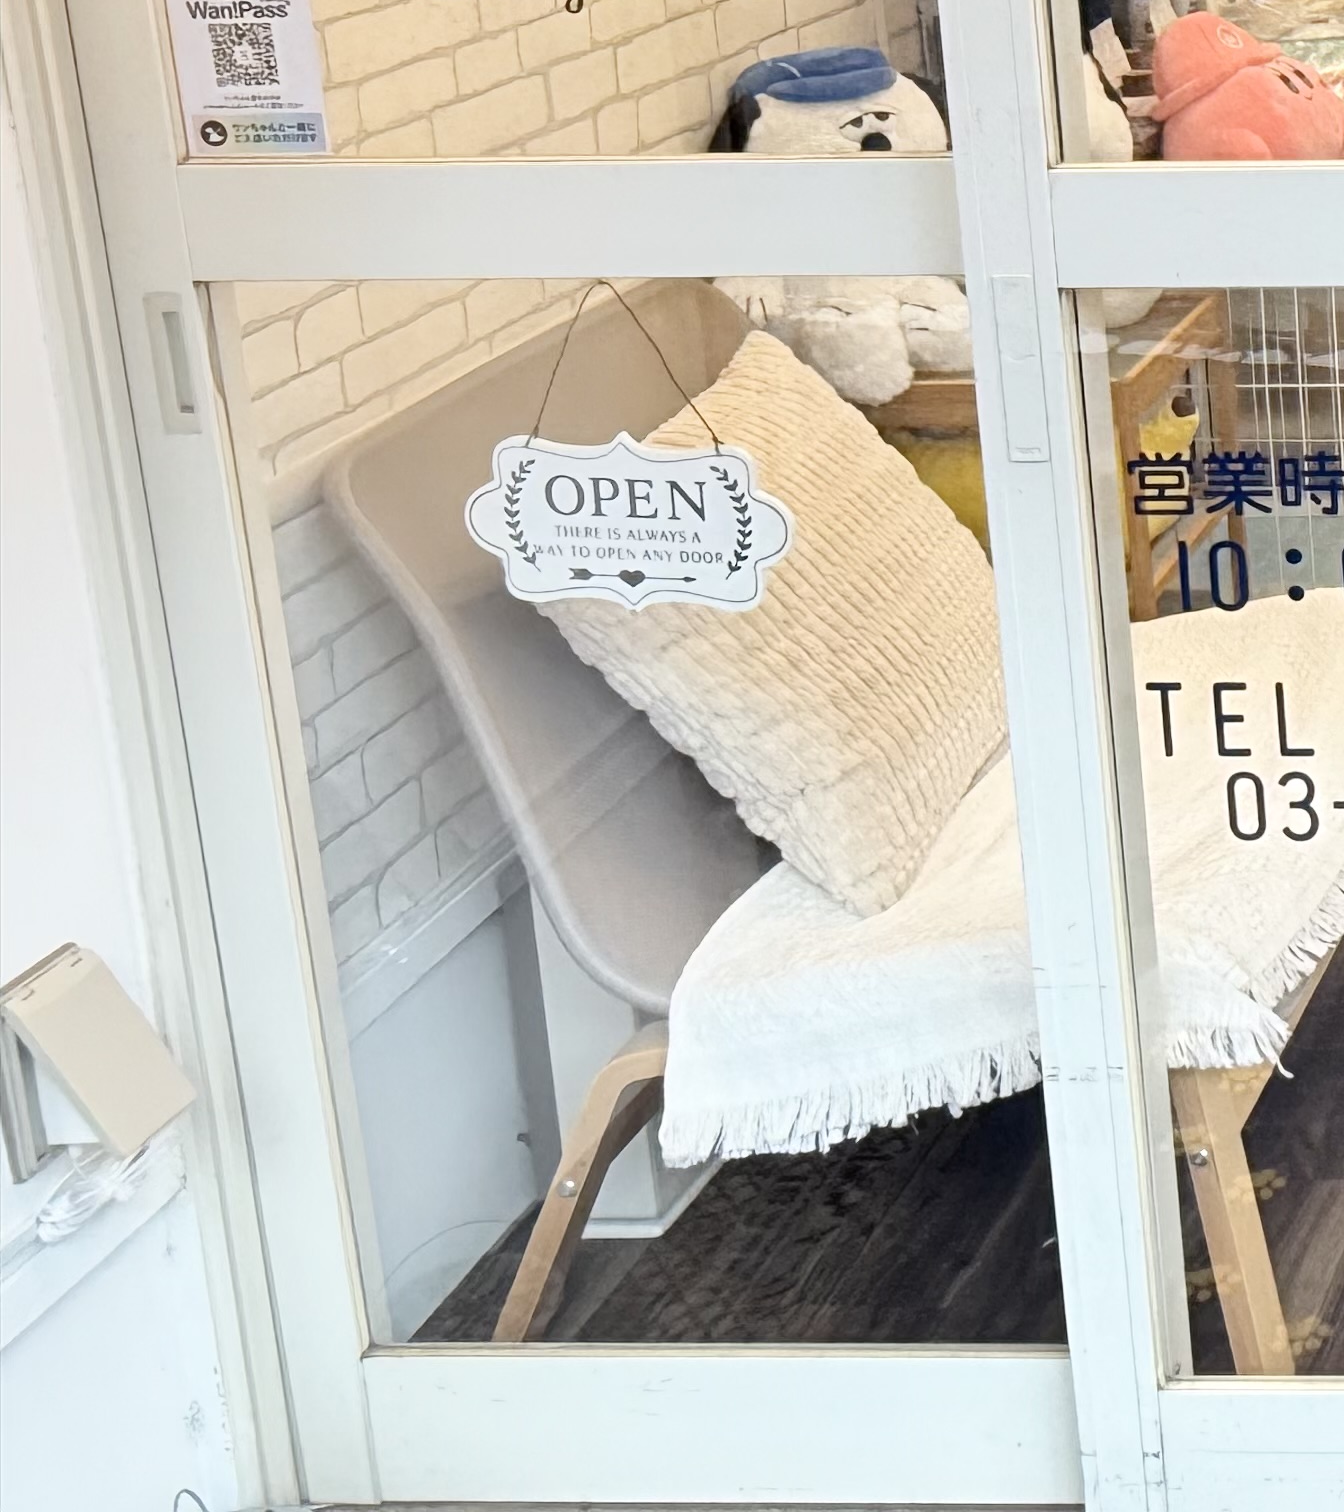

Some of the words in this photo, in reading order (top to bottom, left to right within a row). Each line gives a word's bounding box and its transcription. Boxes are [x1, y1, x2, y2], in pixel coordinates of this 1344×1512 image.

[186, 0, 290, 20] Wan!Pass
[544, 474, 706, 522] OPEN
[554, 524, 601, 539] THERE
[607, 527, 621, 540] IS
[626, 529, 687, 543] ALWAYS
[692, 532, 701, 544] A
[572, 546, 591, 558] TO
[595, 548, 637, 561] OPEN
[642, 552, 673, 563] ANY
[679, 552, 725, 565] DOOR
[1145, 682, 1316, 758] TEL
